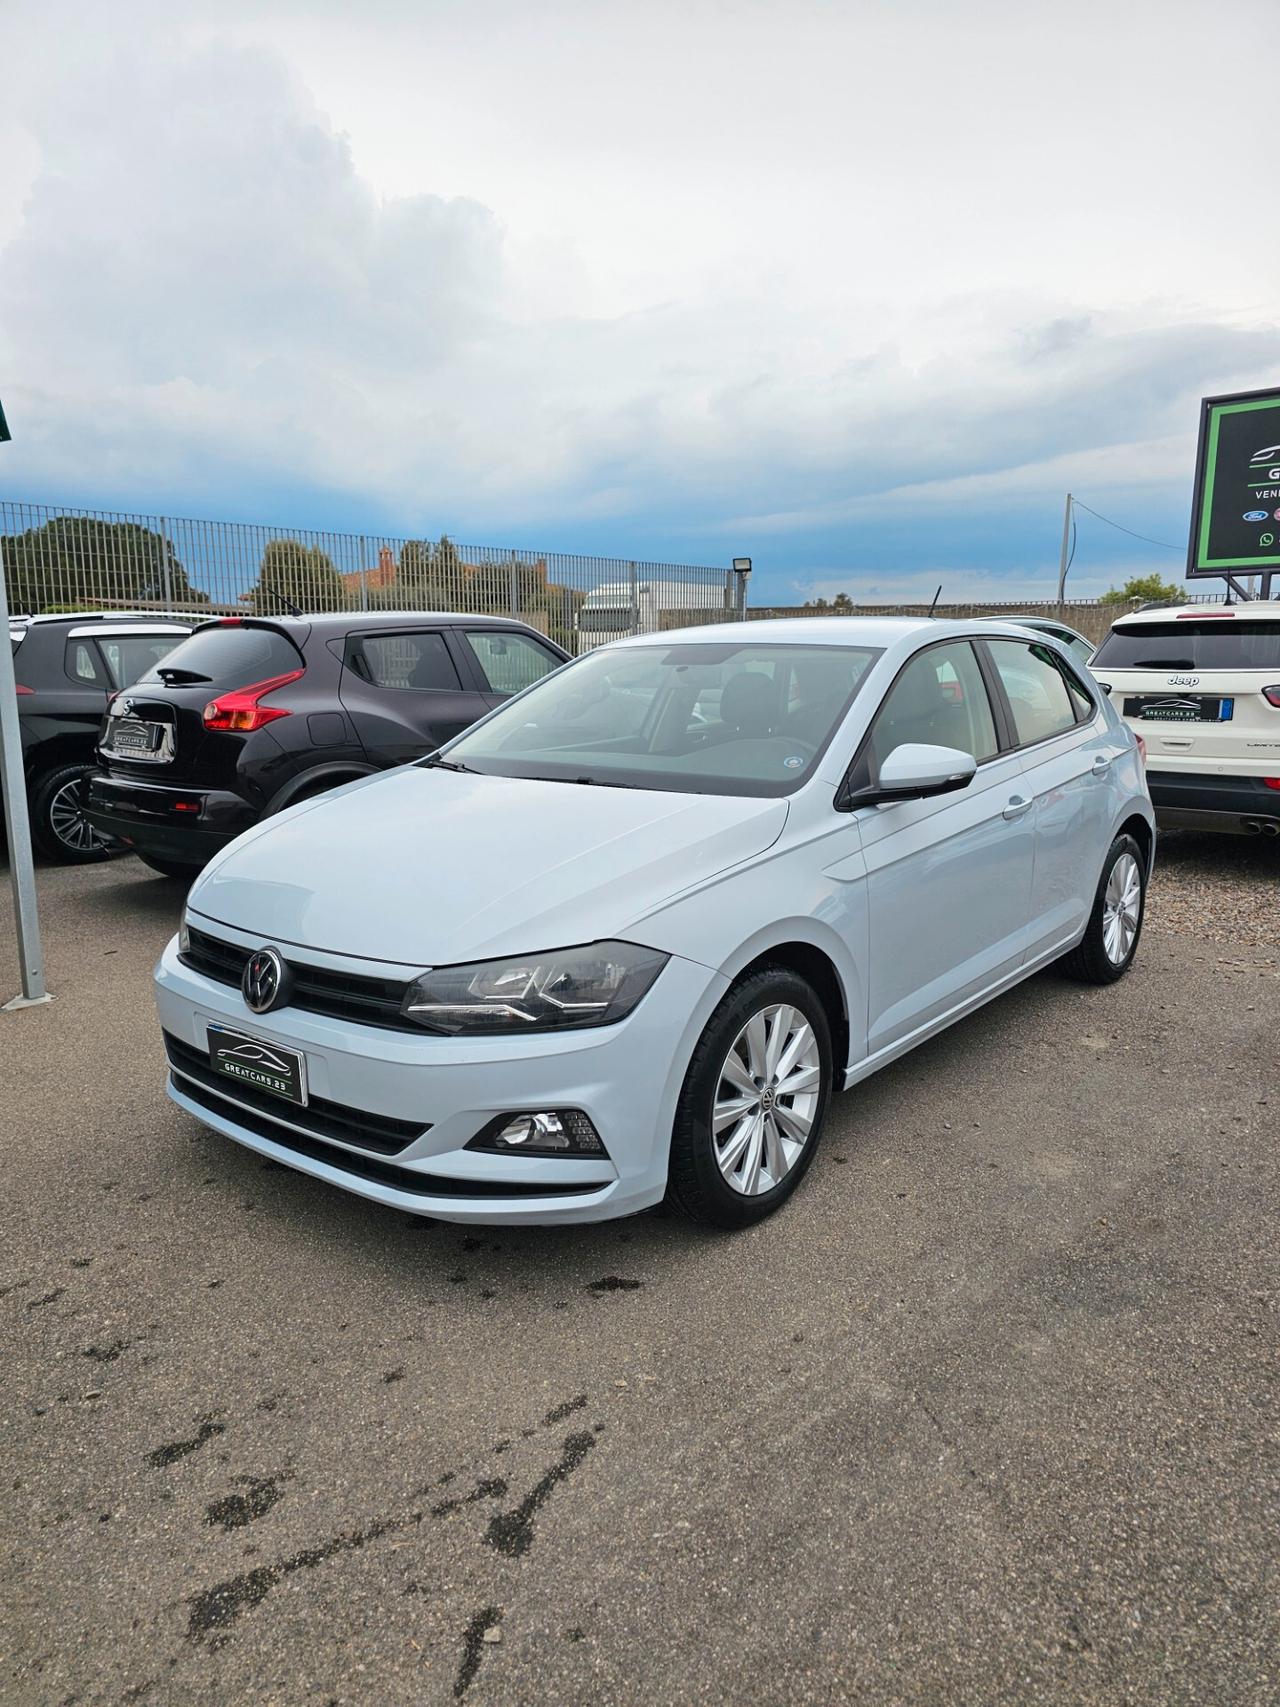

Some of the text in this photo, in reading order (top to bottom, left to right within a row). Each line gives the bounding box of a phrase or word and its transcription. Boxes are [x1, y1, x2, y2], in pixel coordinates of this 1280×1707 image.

[1255, 489, 1280, 499] VEN
[1167, 675, 1200, 687] Jeep
[224, 1063, 286, 1091] GREATCARS.23
